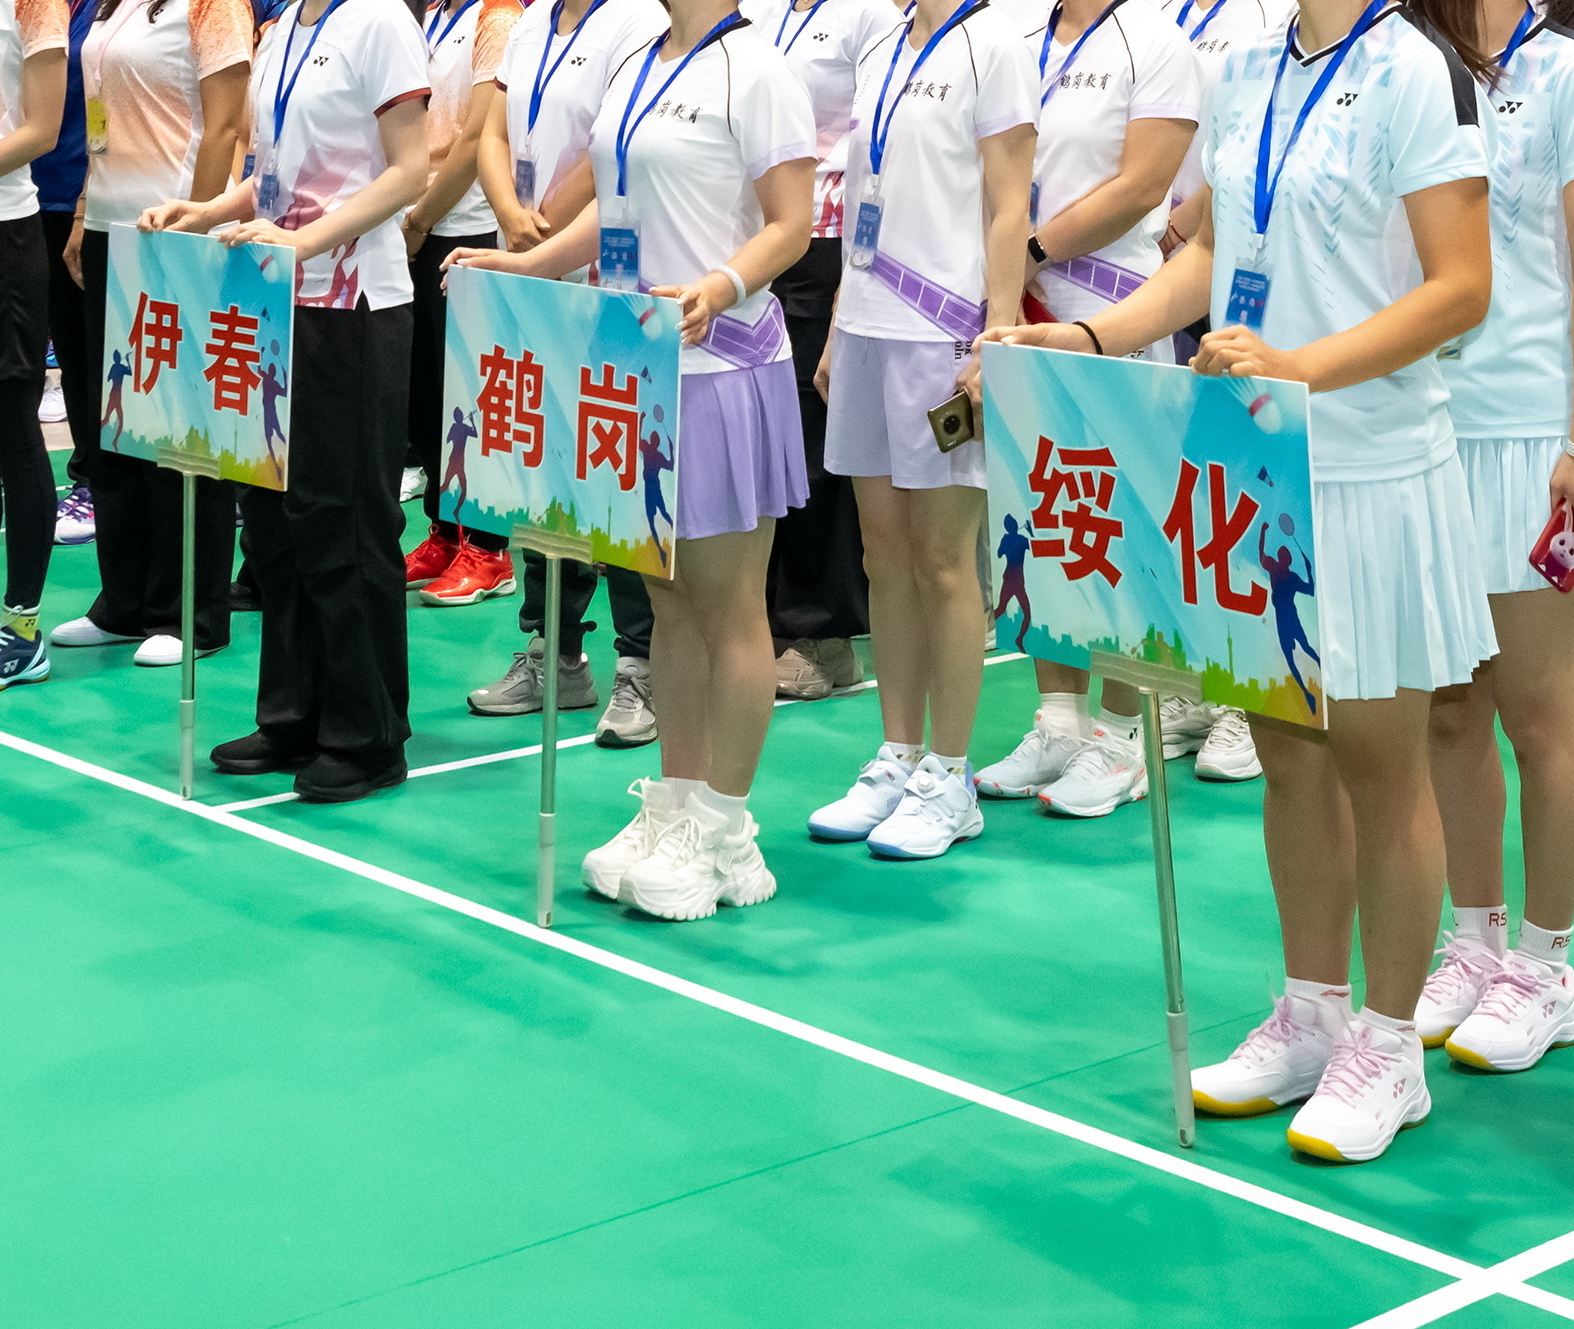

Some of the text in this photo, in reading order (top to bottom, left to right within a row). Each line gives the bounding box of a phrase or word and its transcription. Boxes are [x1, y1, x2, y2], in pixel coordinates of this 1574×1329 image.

[128, 291, 263, 418] 伊春
[476, 343, 640, 492] 鹤岗
[1027, 434, 1270, 617] 绥化
